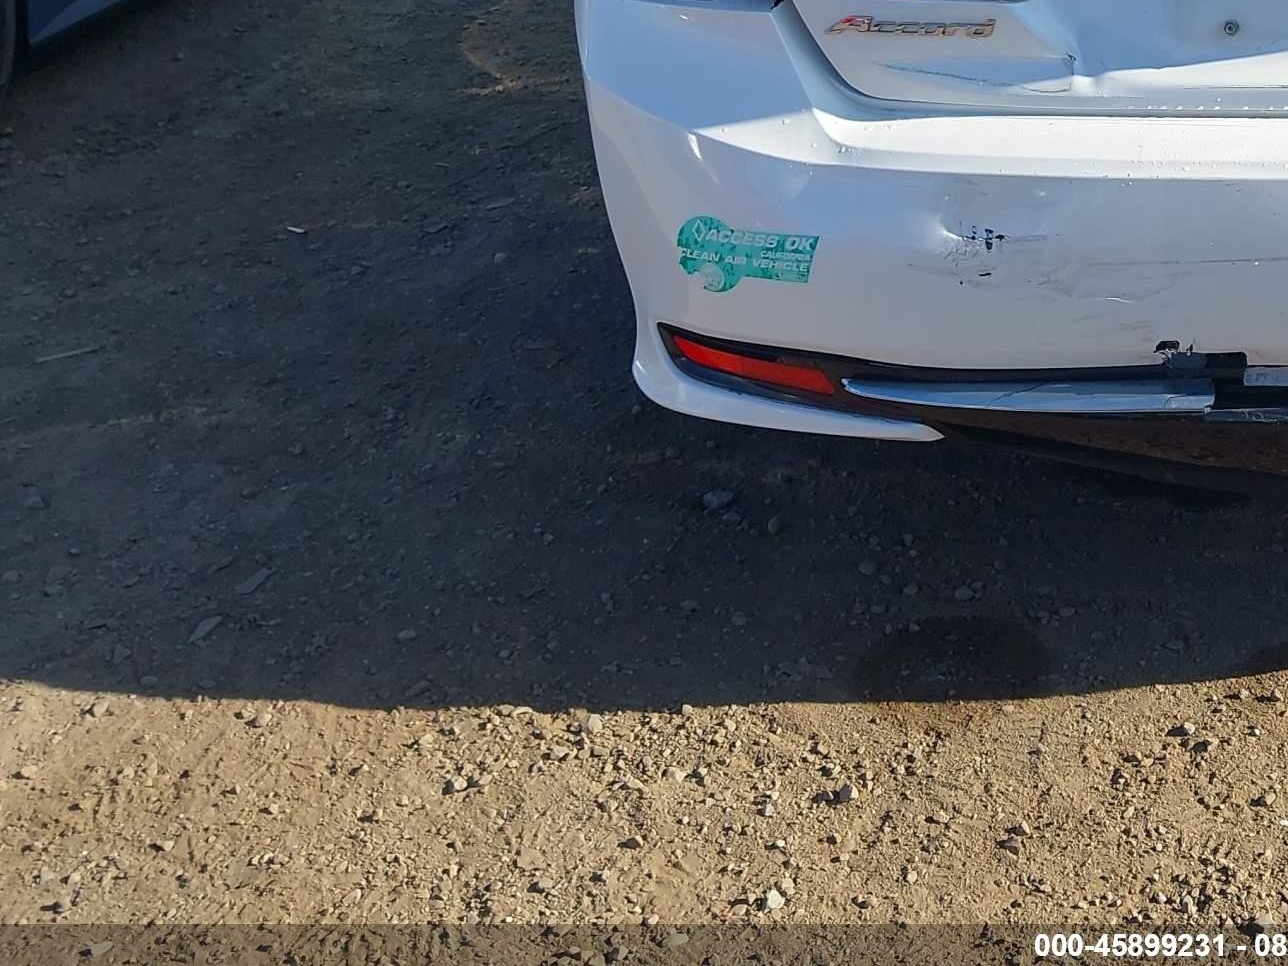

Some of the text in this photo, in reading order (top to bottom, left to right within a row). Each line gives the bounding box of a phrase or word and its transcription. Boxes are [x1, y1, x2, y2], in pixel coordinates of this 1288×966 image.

[826, 15, 996, 38] Accord
[705, 229, 815, 251] ACCESS OK
[680, 248, 809, 272] CLEAN AIR VEHICLE
